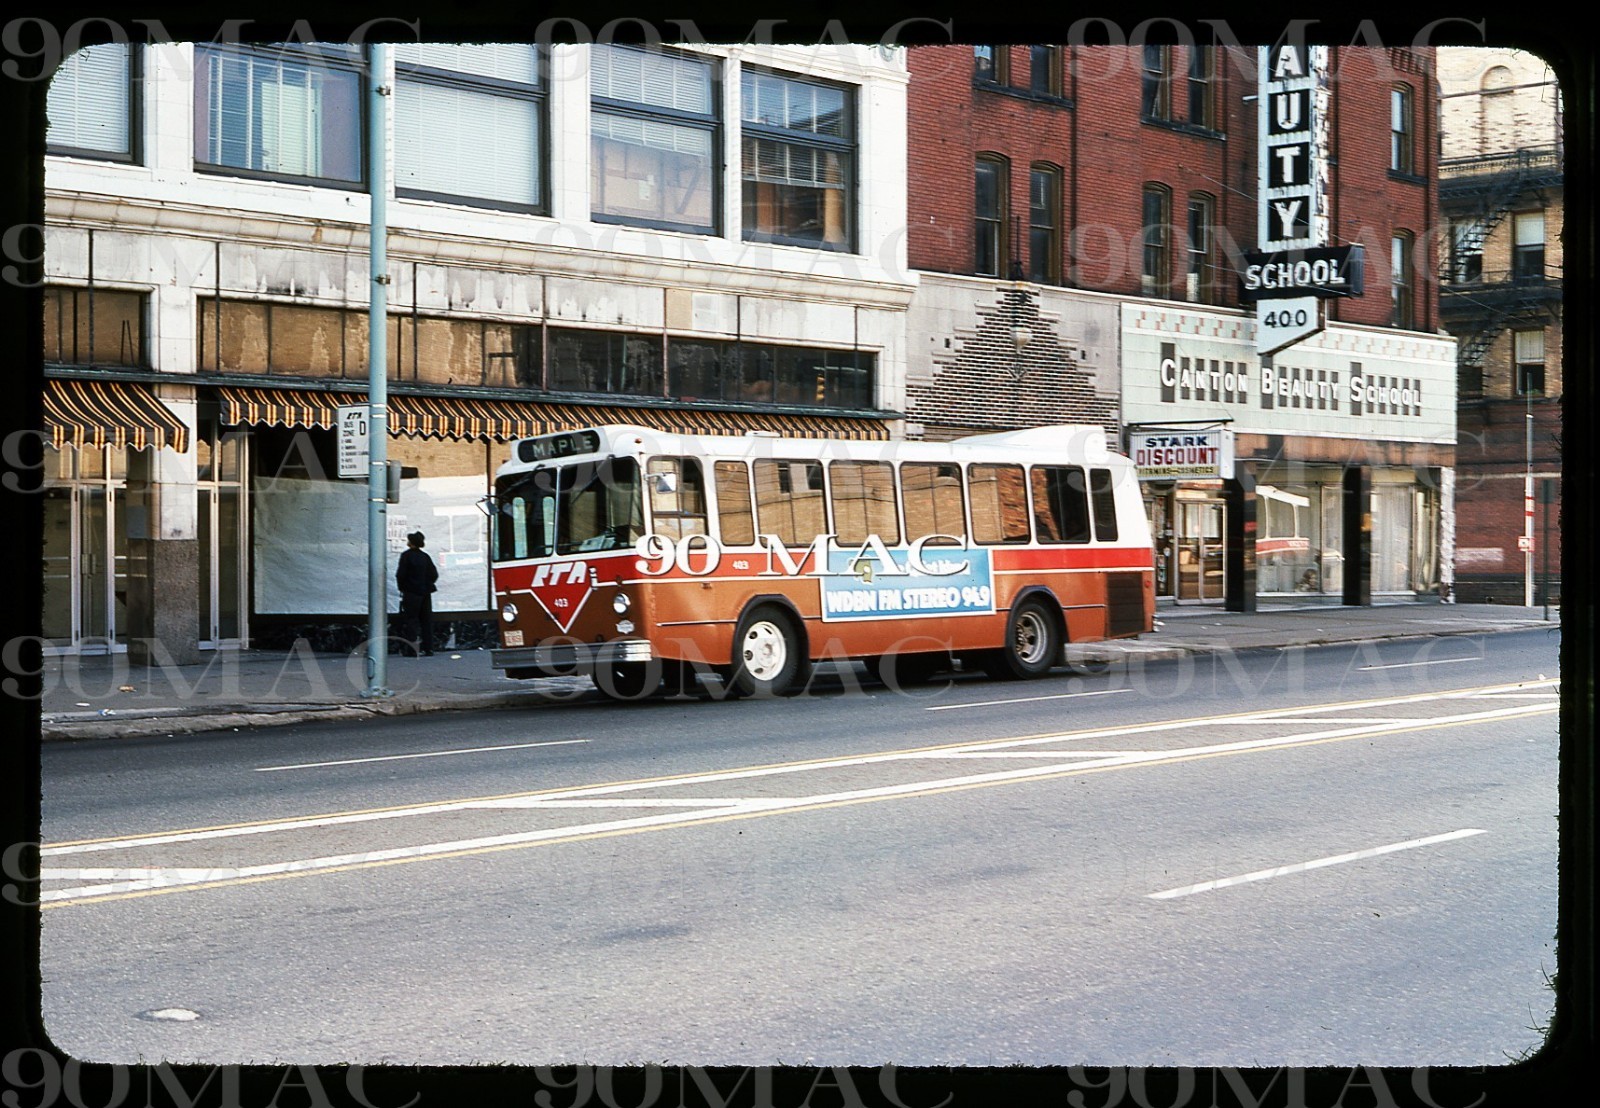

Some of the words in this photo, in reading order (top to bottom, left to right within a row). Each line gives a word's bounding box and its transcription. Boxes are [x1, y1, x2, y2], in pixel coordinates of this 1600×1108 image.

[1245, 259, 1345, 289] SCHOOL
[1264, 309, 1307, 328] 400
[1161, 358, 1248, 393] CANTON
[1261, 367, 1339, 400] BEAUTY
[1351, 376, 1422, 407] SCHOOL
[360, 421, 366, 435] D
[532, 435, 594, 458] MAPLE
[1145, 436, 1208, 447] STARK
[1136, 447, 1219, 466] DISCOUNT
[531, 561, 587, 588] RTA
[827, 589, 878, 613] WDBN
[878, 588, 902, 611] FM
[903, 586, 961, 610] STEREO
